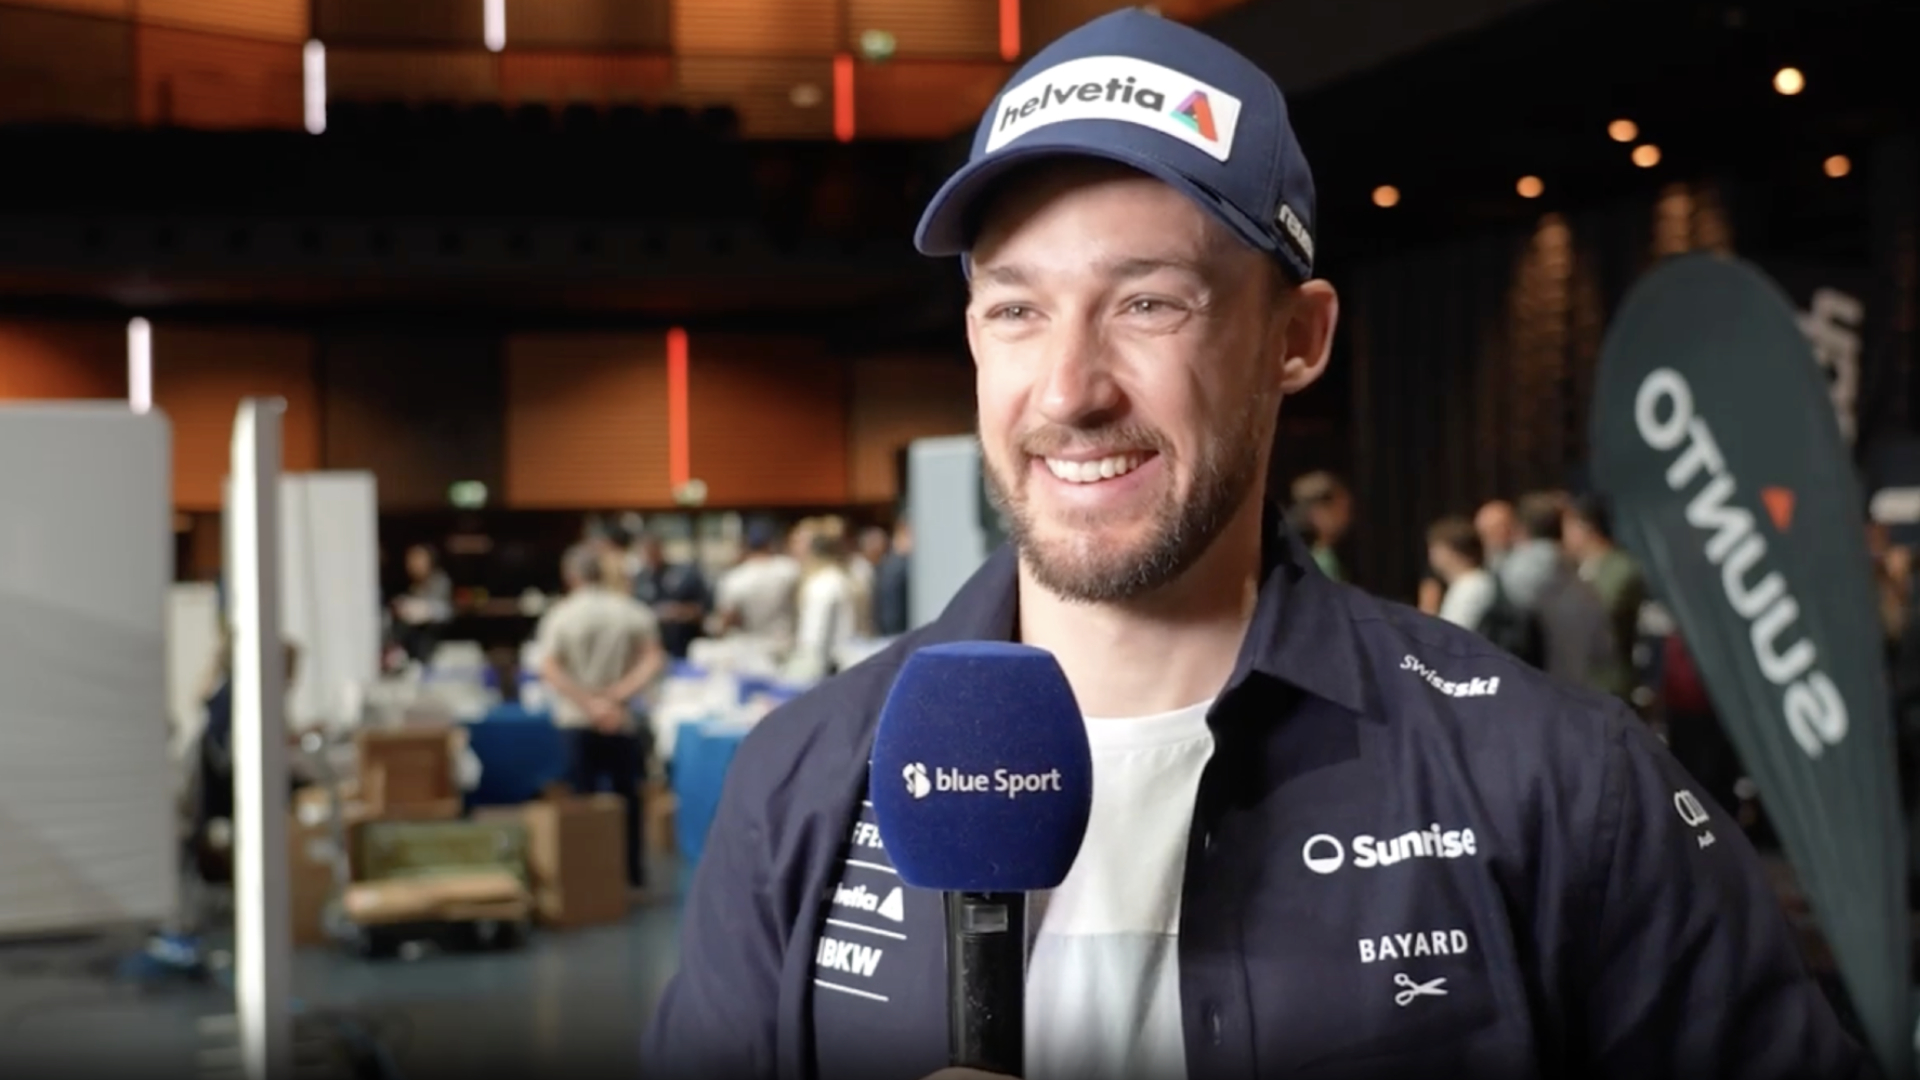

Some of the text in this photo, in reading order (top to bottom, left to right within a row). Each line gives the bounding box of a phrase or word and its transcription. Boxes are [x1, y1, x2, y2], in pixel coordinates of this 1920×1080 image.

[999, 76, 1166, 132] helvetia
[935, 767, 1062, 799] blue Sport
[1352, 823, 1477, 868] Sunrise
[1358, 929, 1469, 963] BAYARD
